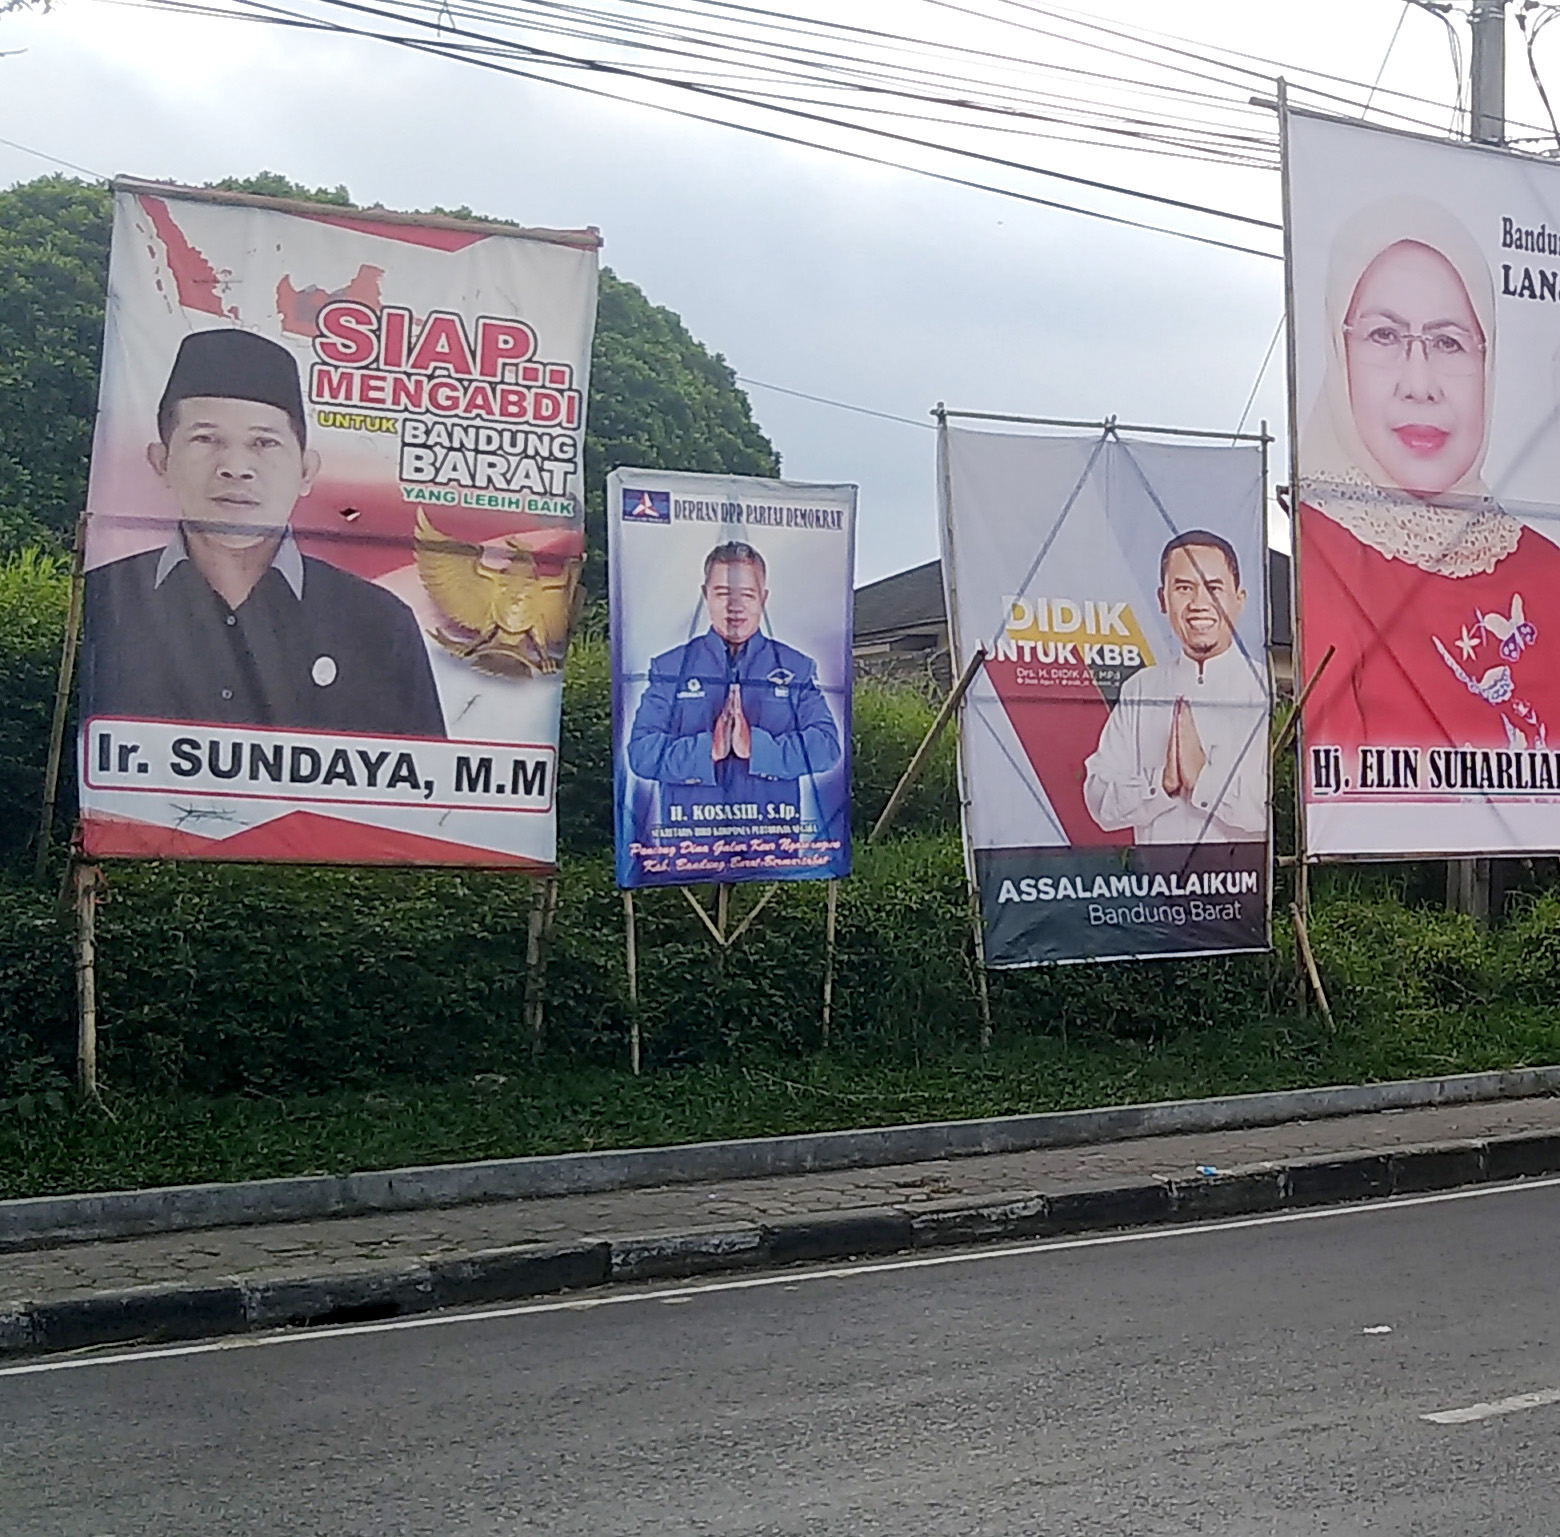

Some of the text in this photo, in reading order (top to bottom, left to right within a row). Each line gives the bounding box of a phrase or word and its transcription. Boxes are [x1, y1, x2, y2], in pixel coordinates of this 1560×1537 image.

[317, 303, 570, 387] SIAP..
[312, 367, 580, 427] MENGABDI
[317, 411, 577, 459] UNTUK BANDUNG
[400, 446, 577, 496] BARAT
[403, 486, 574, 516] YANG LEBIH BAIK
[674, 499, 844, 531] DEPHAN DPP PARTAI DEMOKRAT
[1001, 595, 1130, 637] DIDIK
[976, 637, 1141, 667] UNTUK KBB
[98, 732, 549, 800] Ir. SUNDAYA, M.M
[1312, 748, 1350, 794] Hj.
[1358, 748, 1420, 789] ELIN
[669, 804, 688, 822] H.
[693, 803, 763, 822] KOSASIH,
[997, 871, 1258, 904] ASSALAMUALAIKUM
[1088, 900, 1242, 927] Bandung Barat
